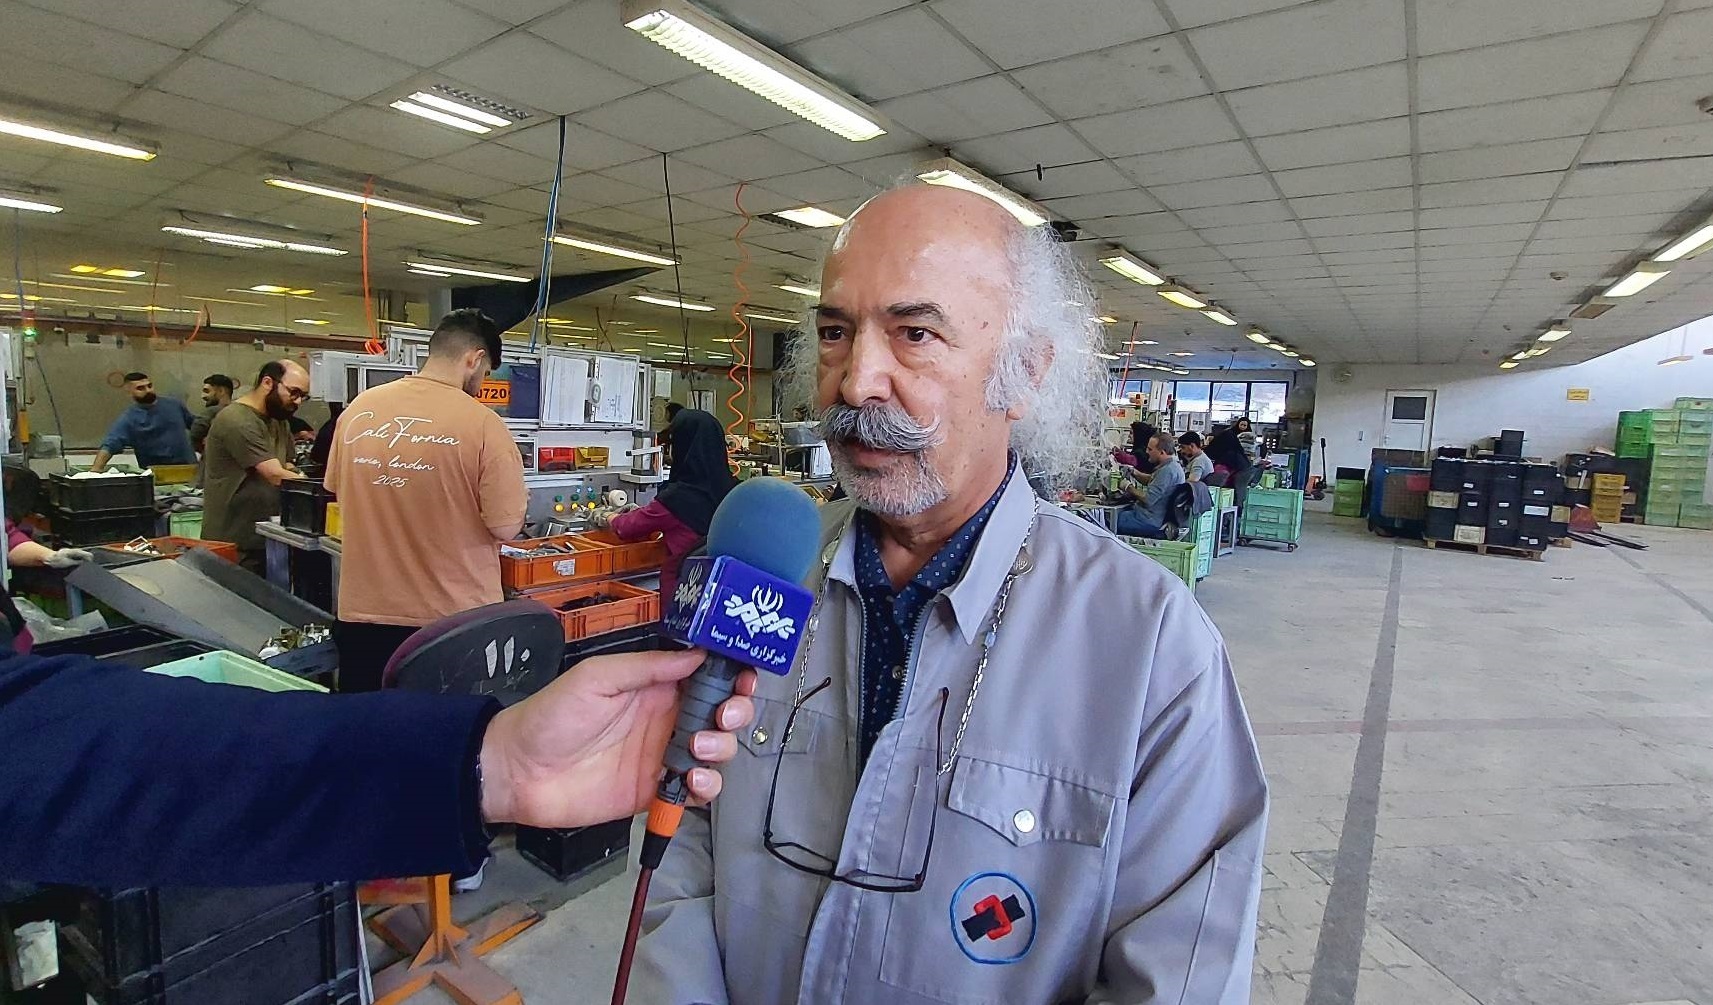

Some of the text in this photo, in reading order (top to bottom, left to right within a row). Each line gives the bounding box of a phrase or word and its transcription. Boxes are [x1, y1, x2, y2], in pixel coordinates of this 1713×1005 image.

[388, 455, 434, 470] london
[371, 474, 409, 488] 2025
[710, 624, 728, 643] سیما
[726, 636, 734, 648] و
[735, 634, 751, 650] صدا
